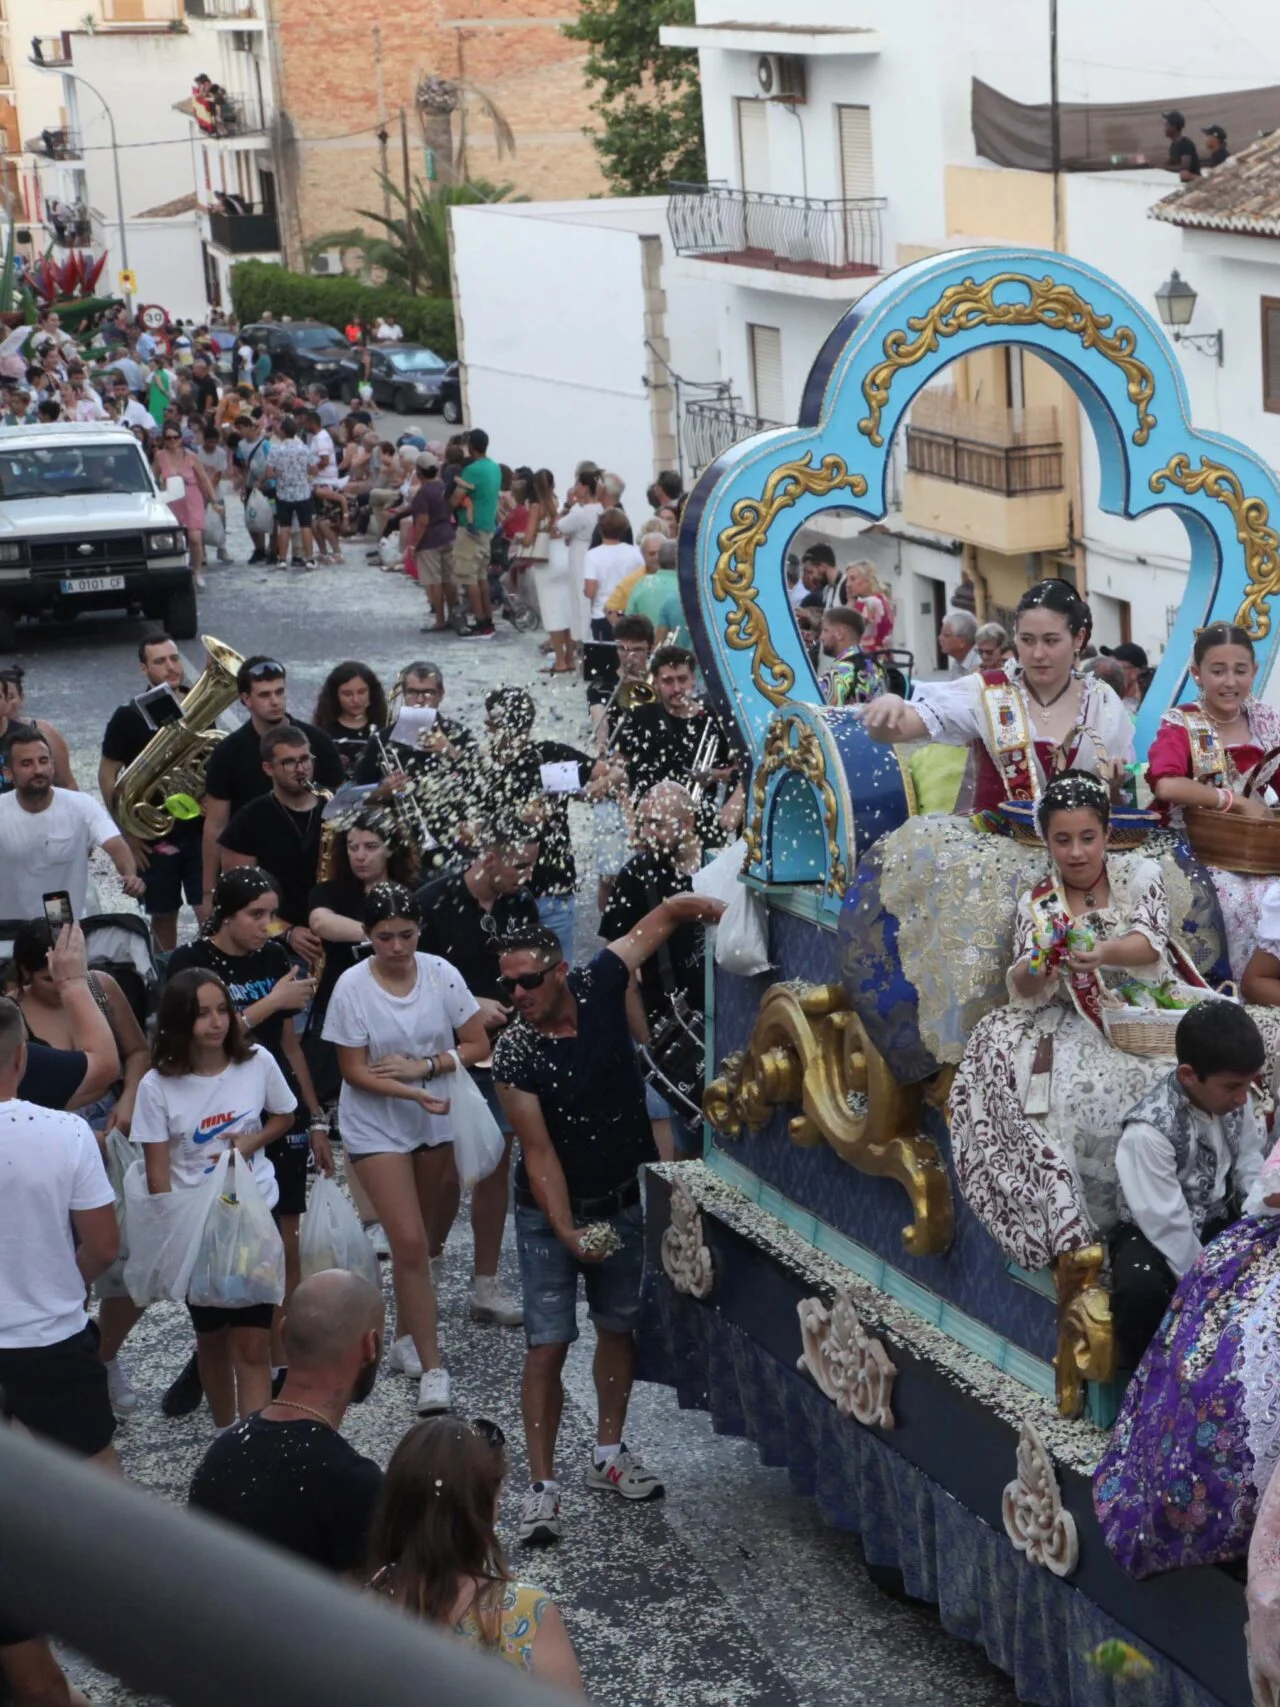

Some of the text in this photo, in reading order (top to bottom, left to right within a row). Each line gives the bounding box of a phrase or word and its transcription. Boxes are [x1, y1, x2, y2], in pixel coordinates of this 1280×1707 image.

[146, 312, 162, 322] 30
[79, 579, 104, 591] 0101
[201, 1110, 236, 1130] NIKE
